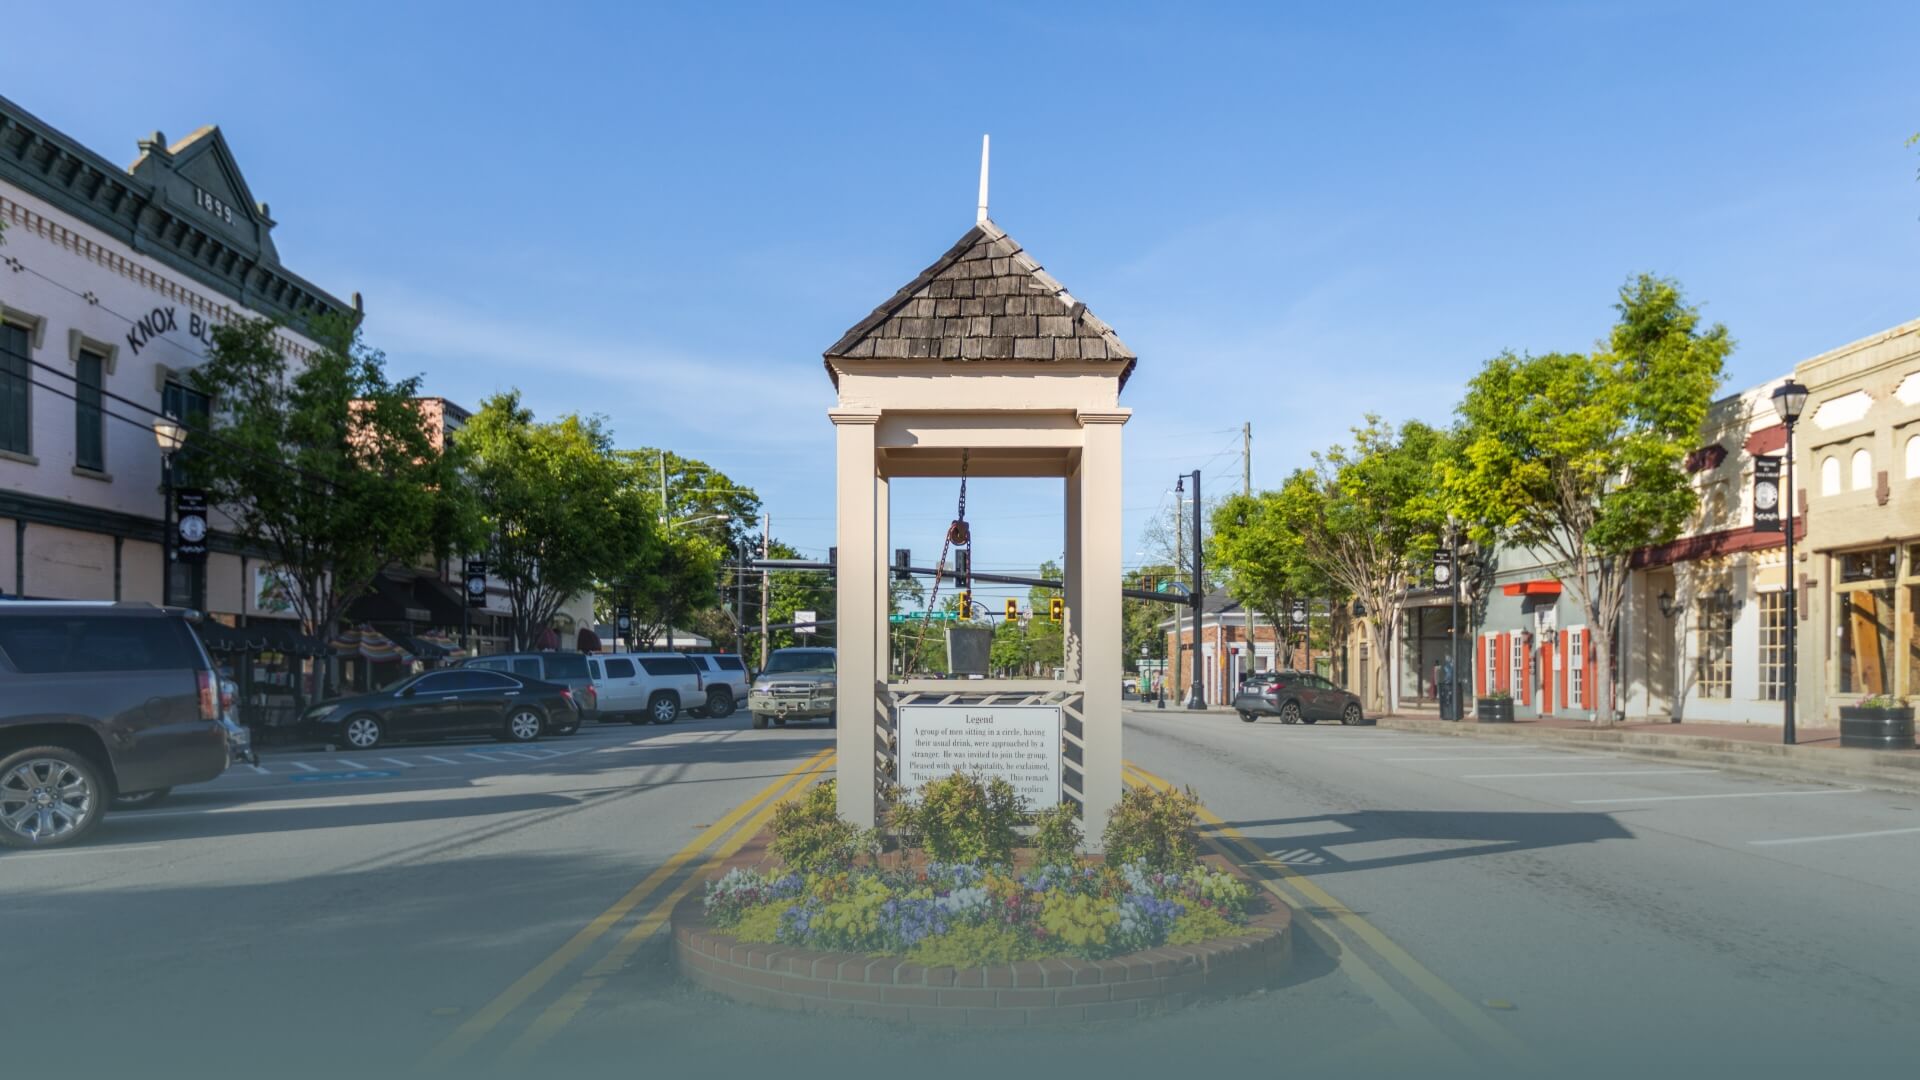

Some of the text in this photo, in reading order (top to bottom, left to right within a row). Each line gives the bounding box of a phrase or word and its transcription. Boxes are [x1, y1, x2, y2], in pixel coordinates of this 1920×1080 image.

[126, 306, 178, 356] KNOX
[965, 714, 994, 725] Legend
[920, 729, 939, 737] group
[965, 728, 986, 737] sitting
[1023, 728, 1046, 737] having
[915, 739, 931, 747] their
[932, 739, 951, 747] usual
[991, 739, 1029, 749] approached
[1030, 740, 1038, 749] by
[943, 750, 952, 758] He
[967, 750, 990, 758] invited
[1000, 750, 1013, 760] join
[1014, 750, 1024, 758] the
[909, 761, 935, 769] Pleased
[936, 761, 950, 769] with
[1006, 761, 1014, 769] he
[1010, 772, 1023, 780] This
[1025, 772, 1049, 781] remark
[1021, 783, 1044, 794] replica
